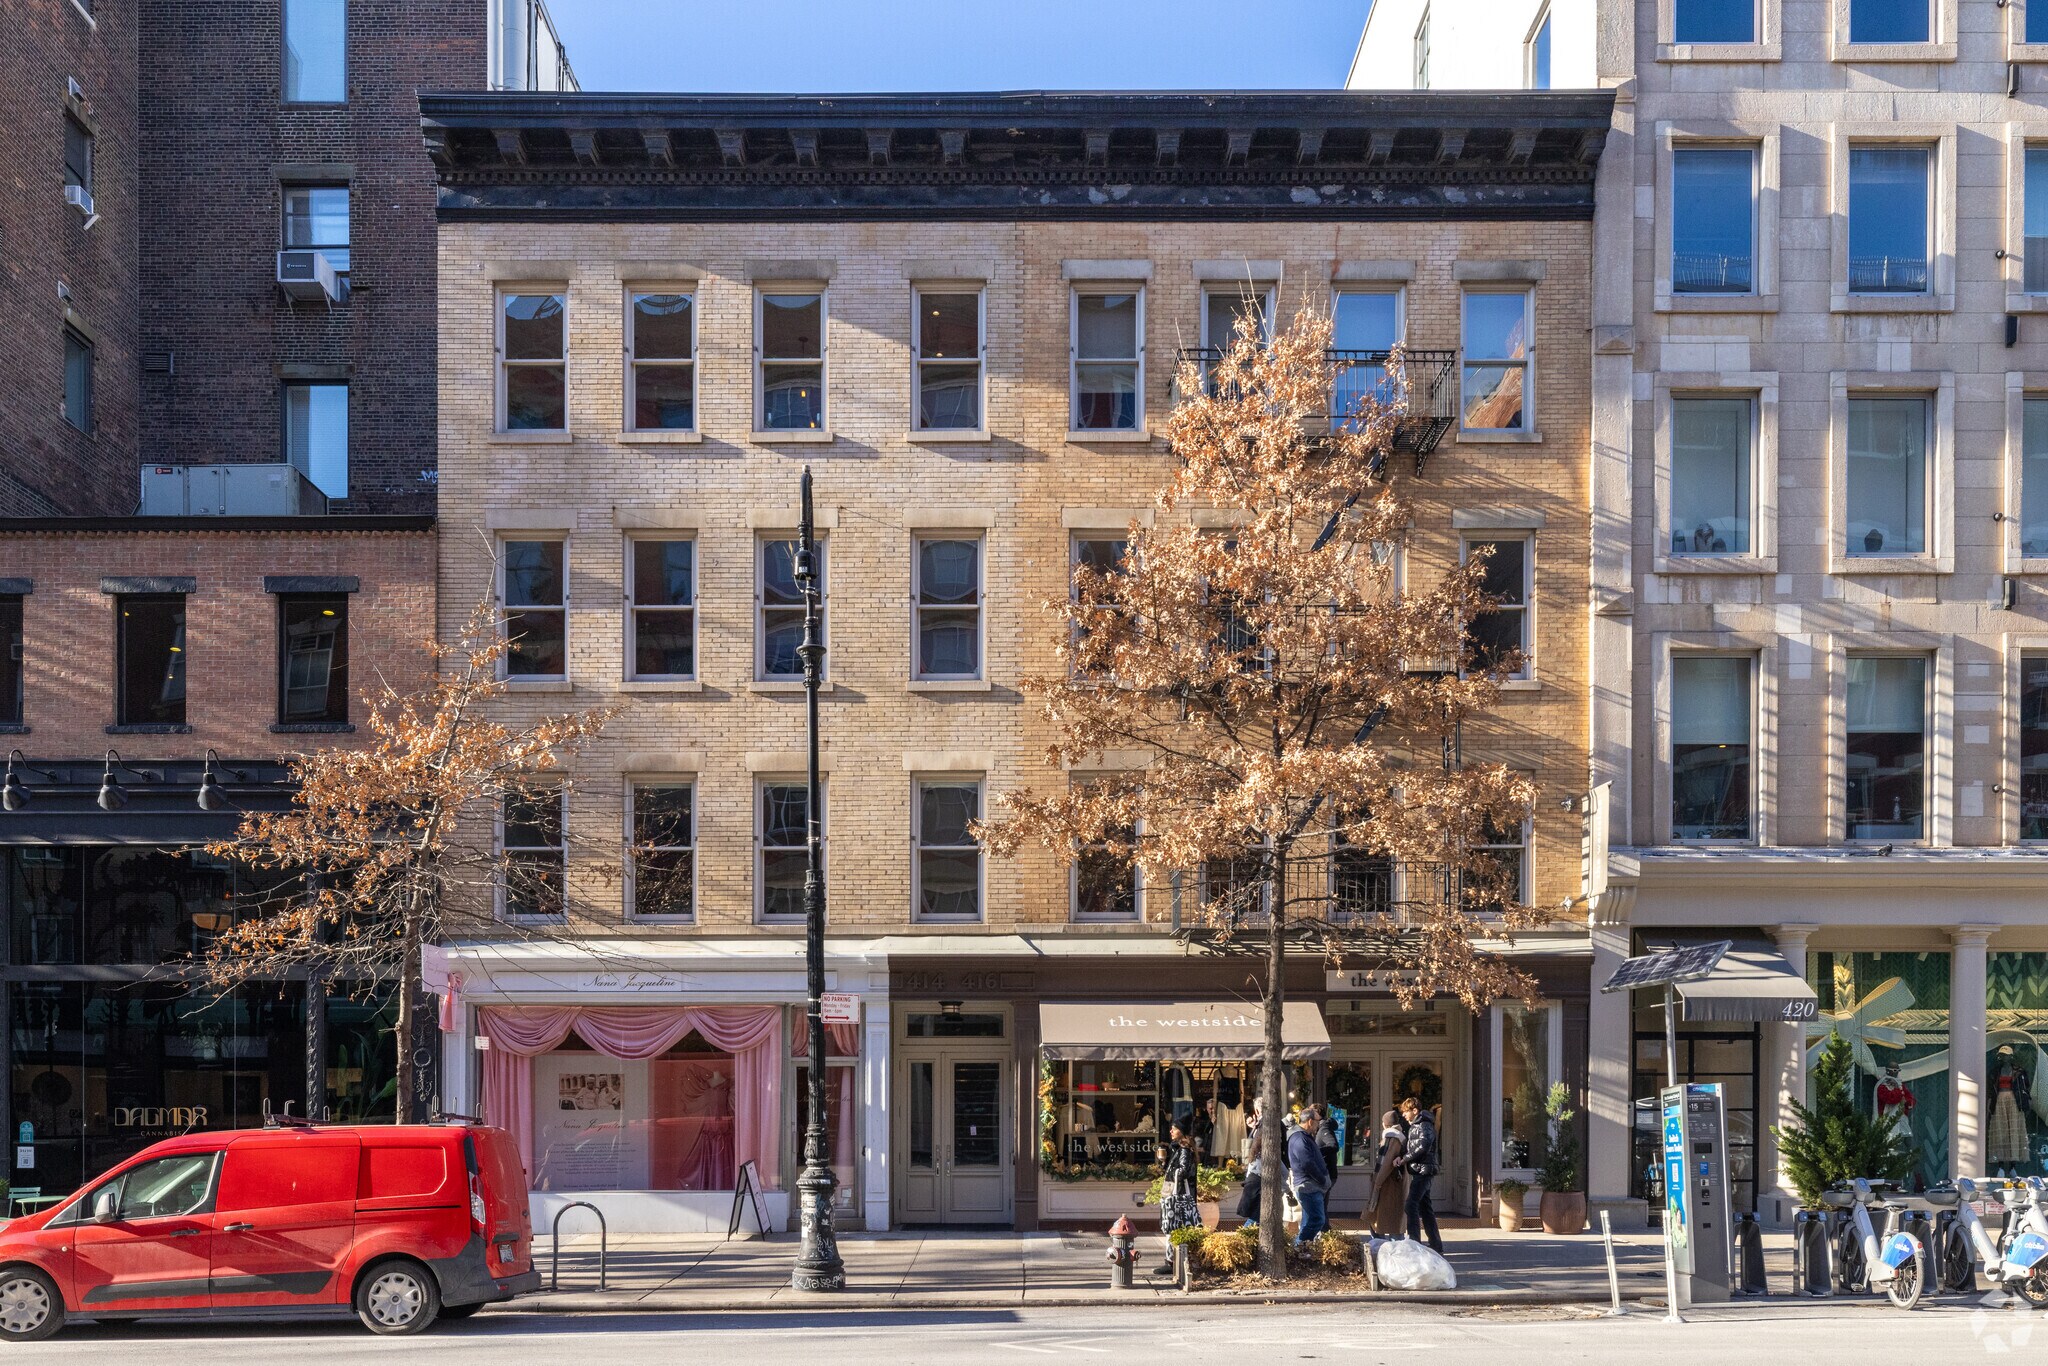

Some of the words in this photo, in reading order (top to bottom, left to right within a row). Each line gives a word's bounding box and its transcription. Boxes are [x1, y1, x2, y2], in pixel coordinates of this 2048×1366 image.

[583, 974, 618, 987] Nana
[620, 972, 677, 991] Jacqueline
[906, 971, 945, 989] 414
[961, 971, 997, 989] 416
[1350, 972, 1377, 987] the
[1782, 1001, 1815, 1017] 420
[1109, 1016, 1148, 1027] the
[1156, 1016, 1262, 1027] westside
[114, 1106, 208, 1126] DAGMAR
[1067, 1139, 1092, 1153] the
[1096, 1139, 1160, 1153] westside
